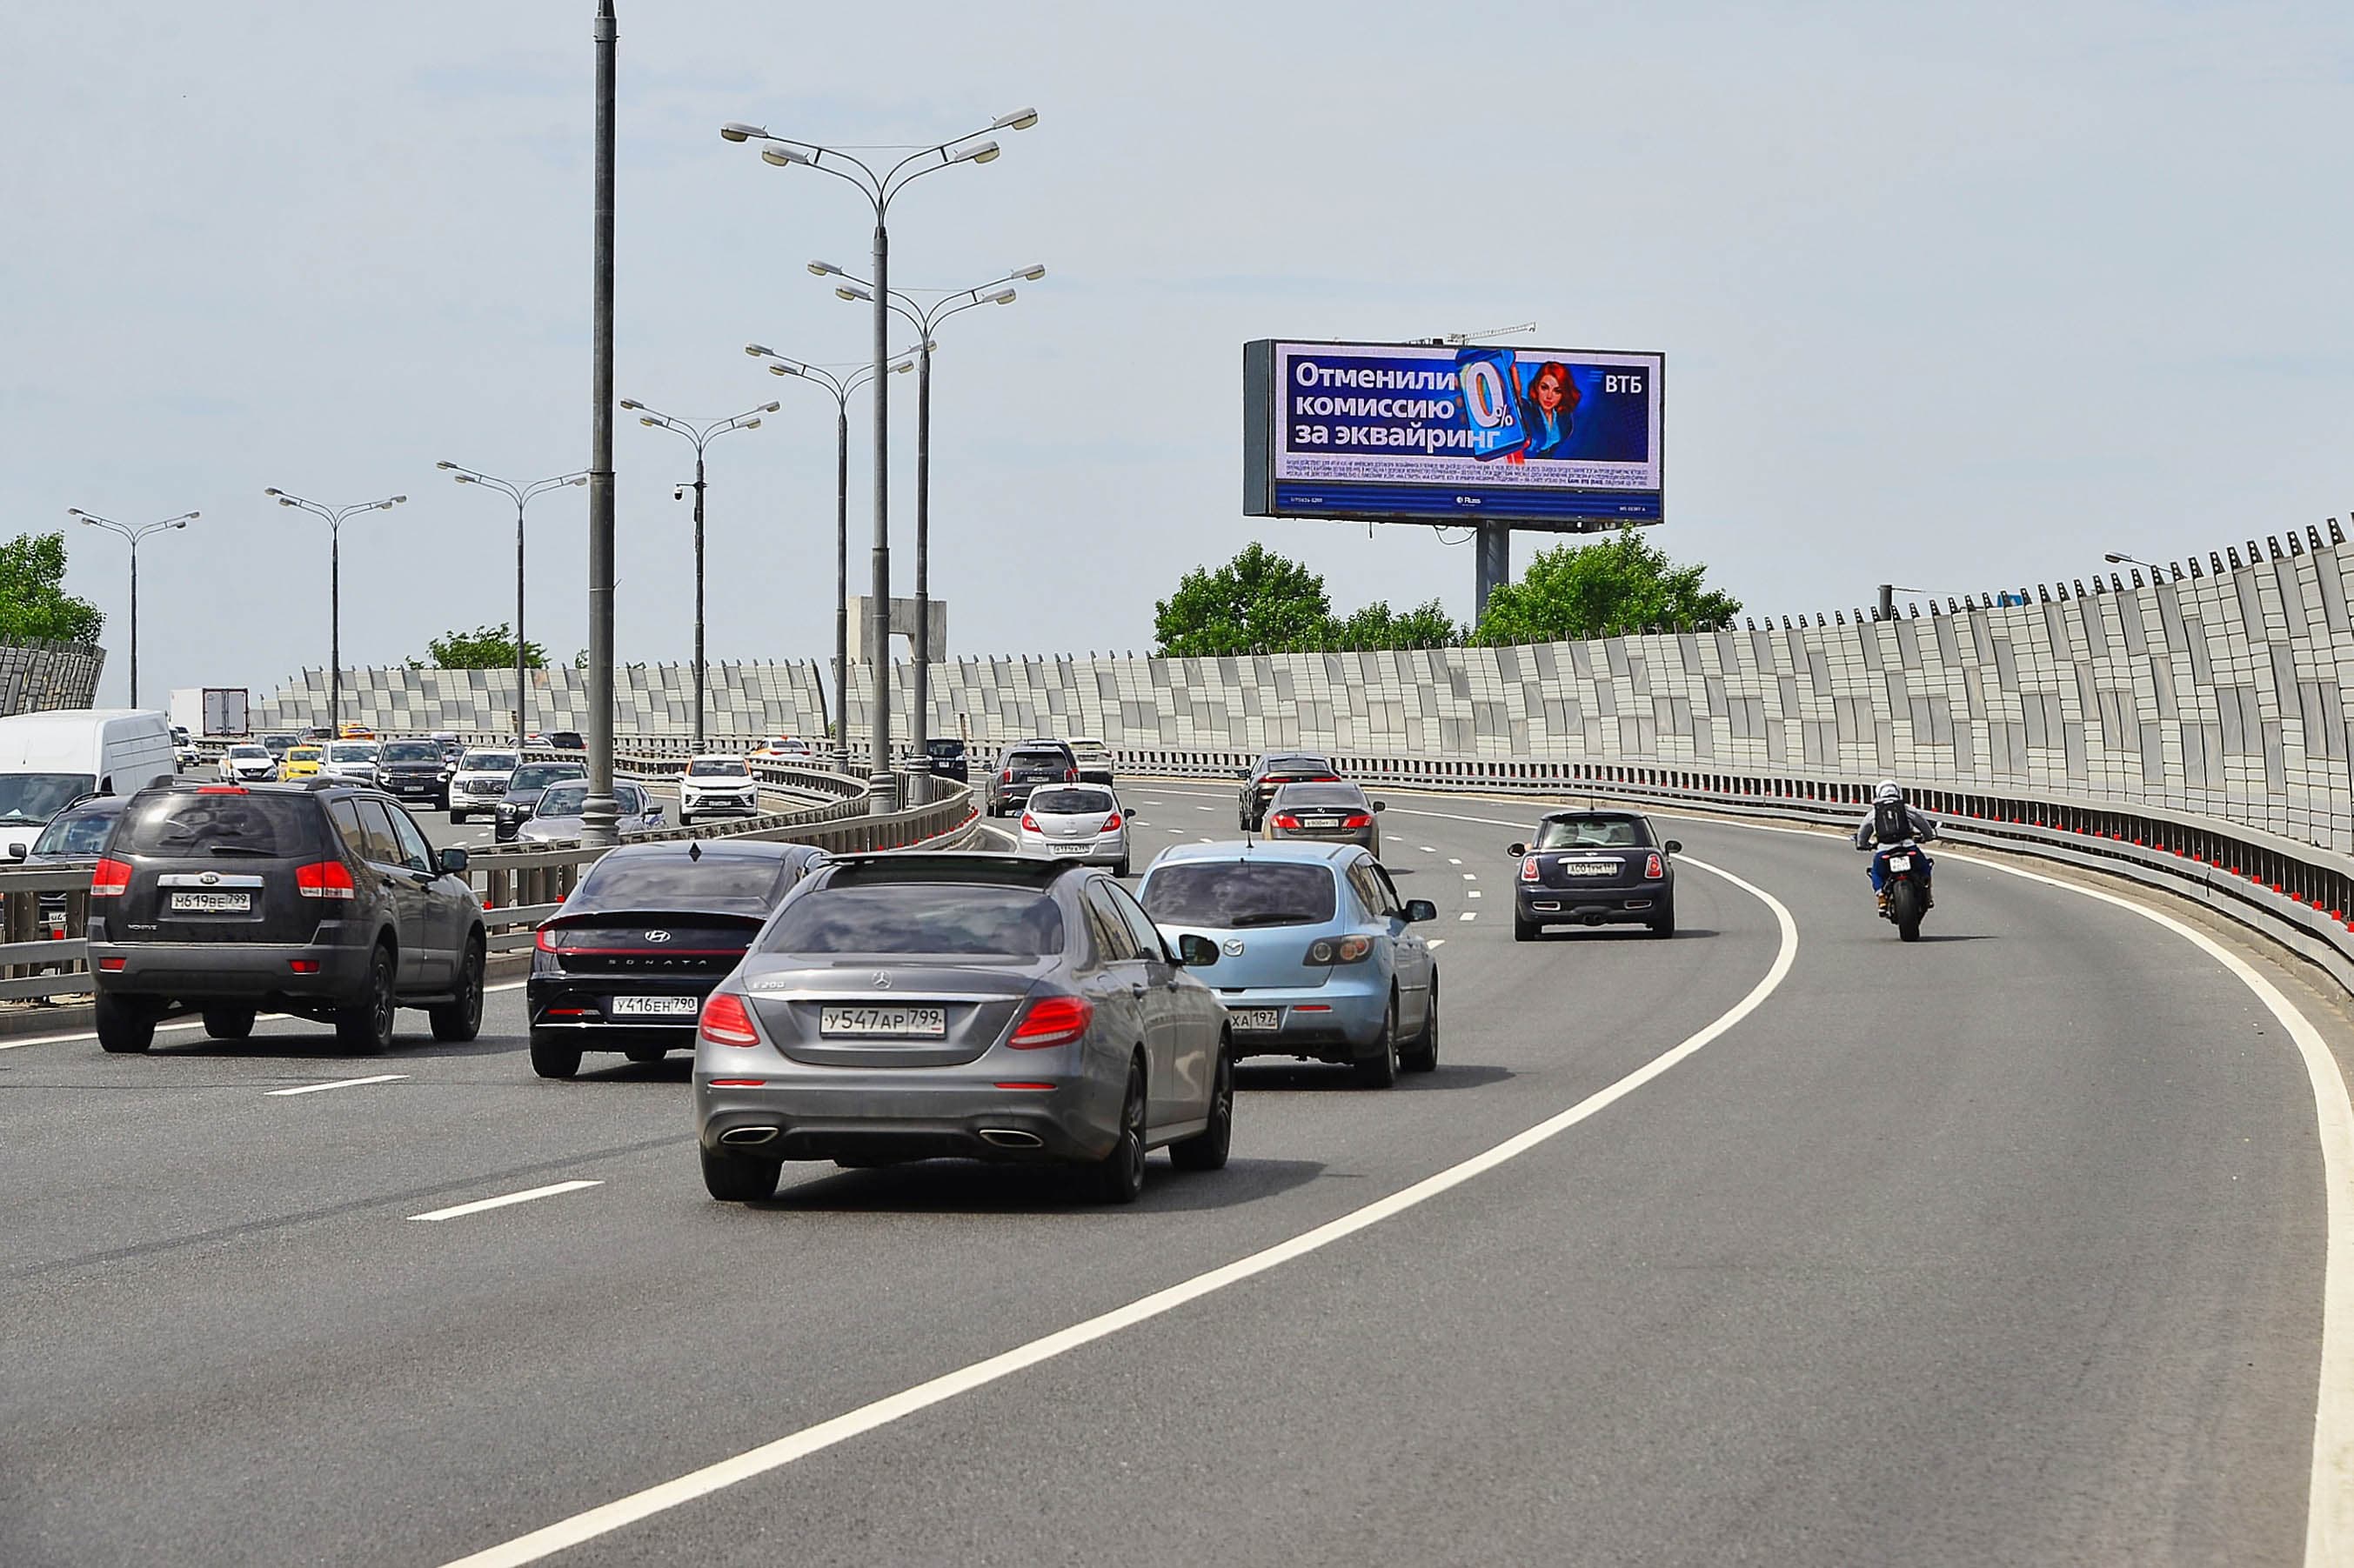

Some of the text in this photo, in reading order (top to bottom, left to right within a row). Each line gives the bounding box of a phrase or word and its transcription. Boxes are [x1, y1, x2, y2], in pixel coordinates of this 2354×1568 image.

[1296, 362, 1455, 390] Отменили
[1606, 375, 1642, 394] ВТБ
[1296, 397, 1455, 419] комиссию
[1294, 422, 1501, 454] за эквайринг
